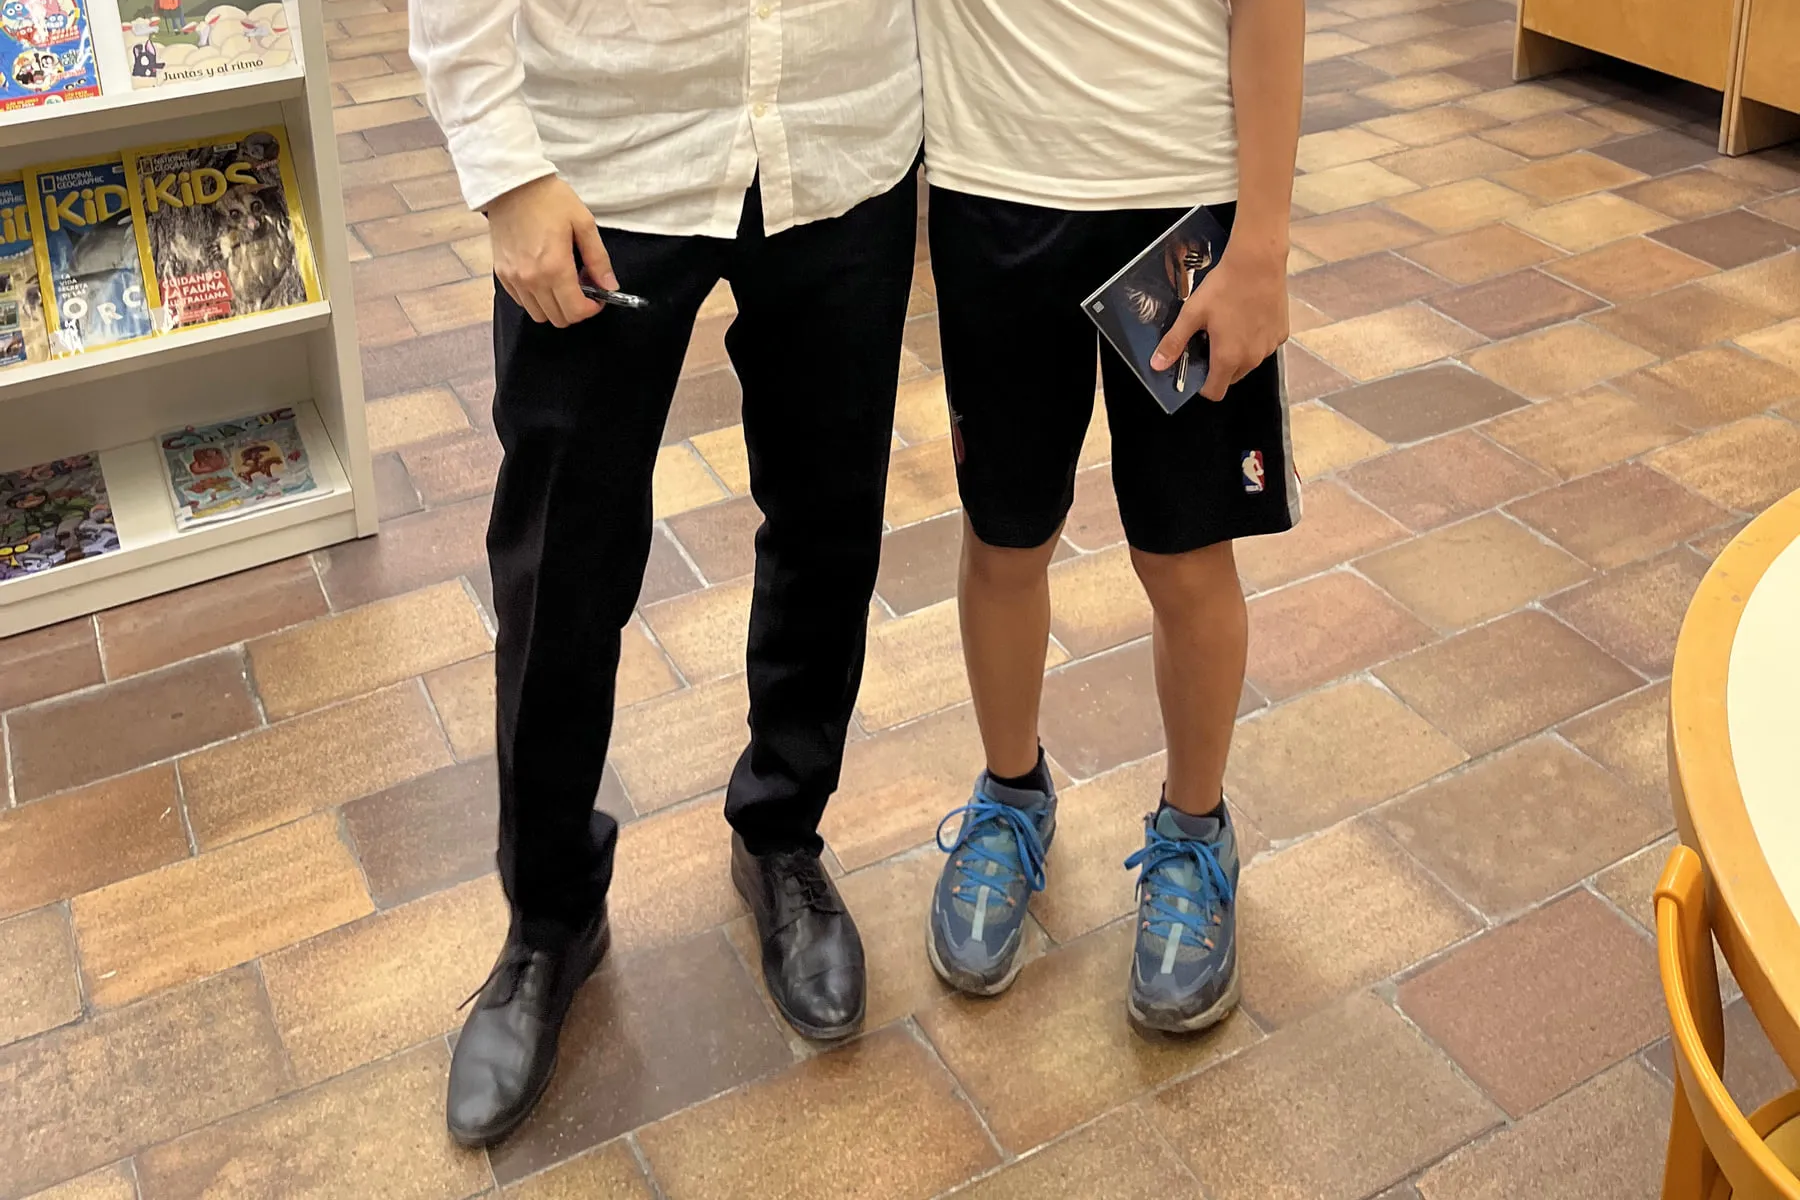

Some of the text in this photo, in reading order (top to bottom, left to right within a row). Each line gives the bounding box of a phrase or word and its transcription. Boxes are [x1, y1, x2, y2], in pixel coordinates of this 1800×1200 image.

[163, 58, 264, 81] Juntas y al ritmo
[56, 170, 92, 182] NATIONAL
[57, 176, 104, 190] GEOGRAPHIC
[182, 280, 226, 296] FAUNA
